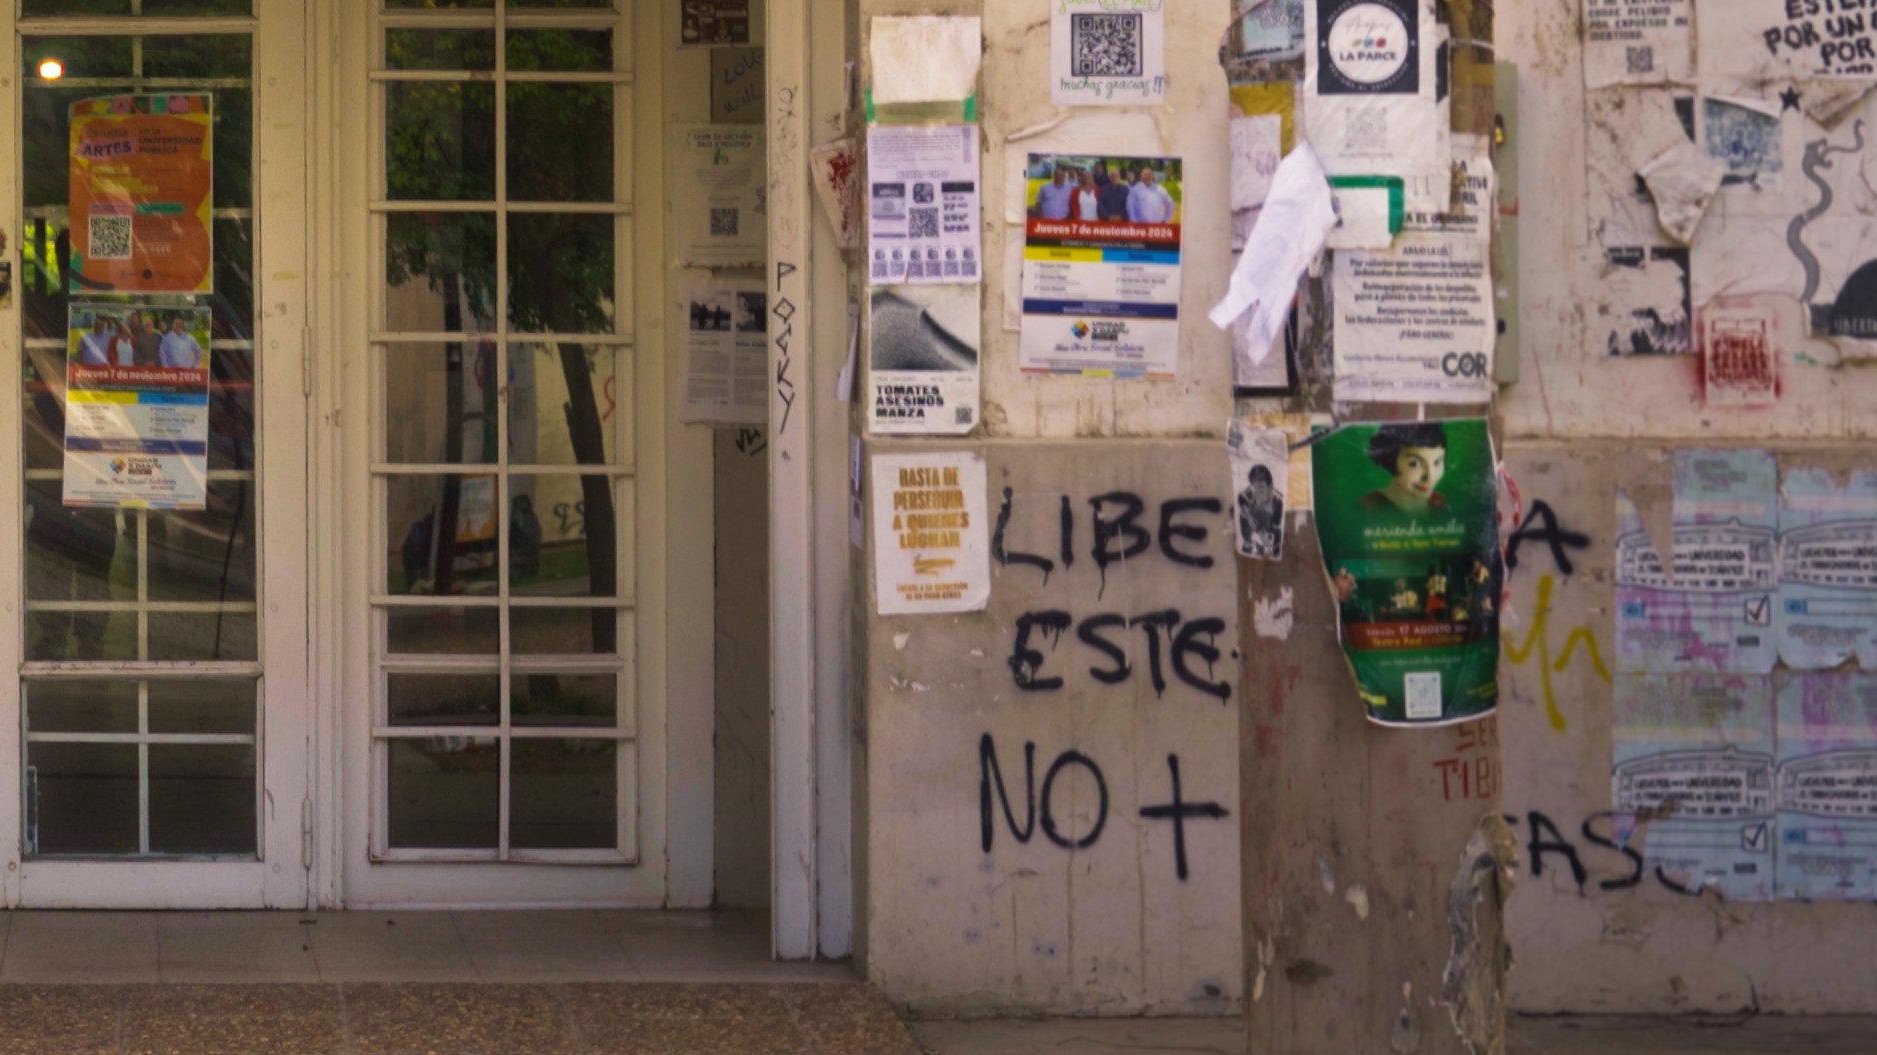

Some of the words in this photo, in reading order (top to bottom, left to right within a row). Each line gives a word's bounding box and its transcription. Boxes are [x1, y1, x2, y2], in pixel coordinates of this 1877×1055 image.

[1764, 21, 1821, 56] POR
[1825, 12, 1865, 39] UN
[1339, 52, 1355, 61] LA
[1357, 52, 1397, 61] PARCE
[1820, 36, 1876, 67] POR
[1034, 222, 1070, 235] Jueves
[1079, 224, 1091, 234] de
[1092, 225, 1147, 237] noviembre
[1441, 351, 1487, 378] COR
[129, 371, 178, 382] noviembre
[876, 385, 940, 395] TOMATES
[876, 396, 944, 406] ASESINOS
[876, 408, 926, 418] MANZA
[899, 466, 940, 487] BASTA
[1010, 610, 1232, 699] ESTE
[980, 733, 1109, 853] NO
